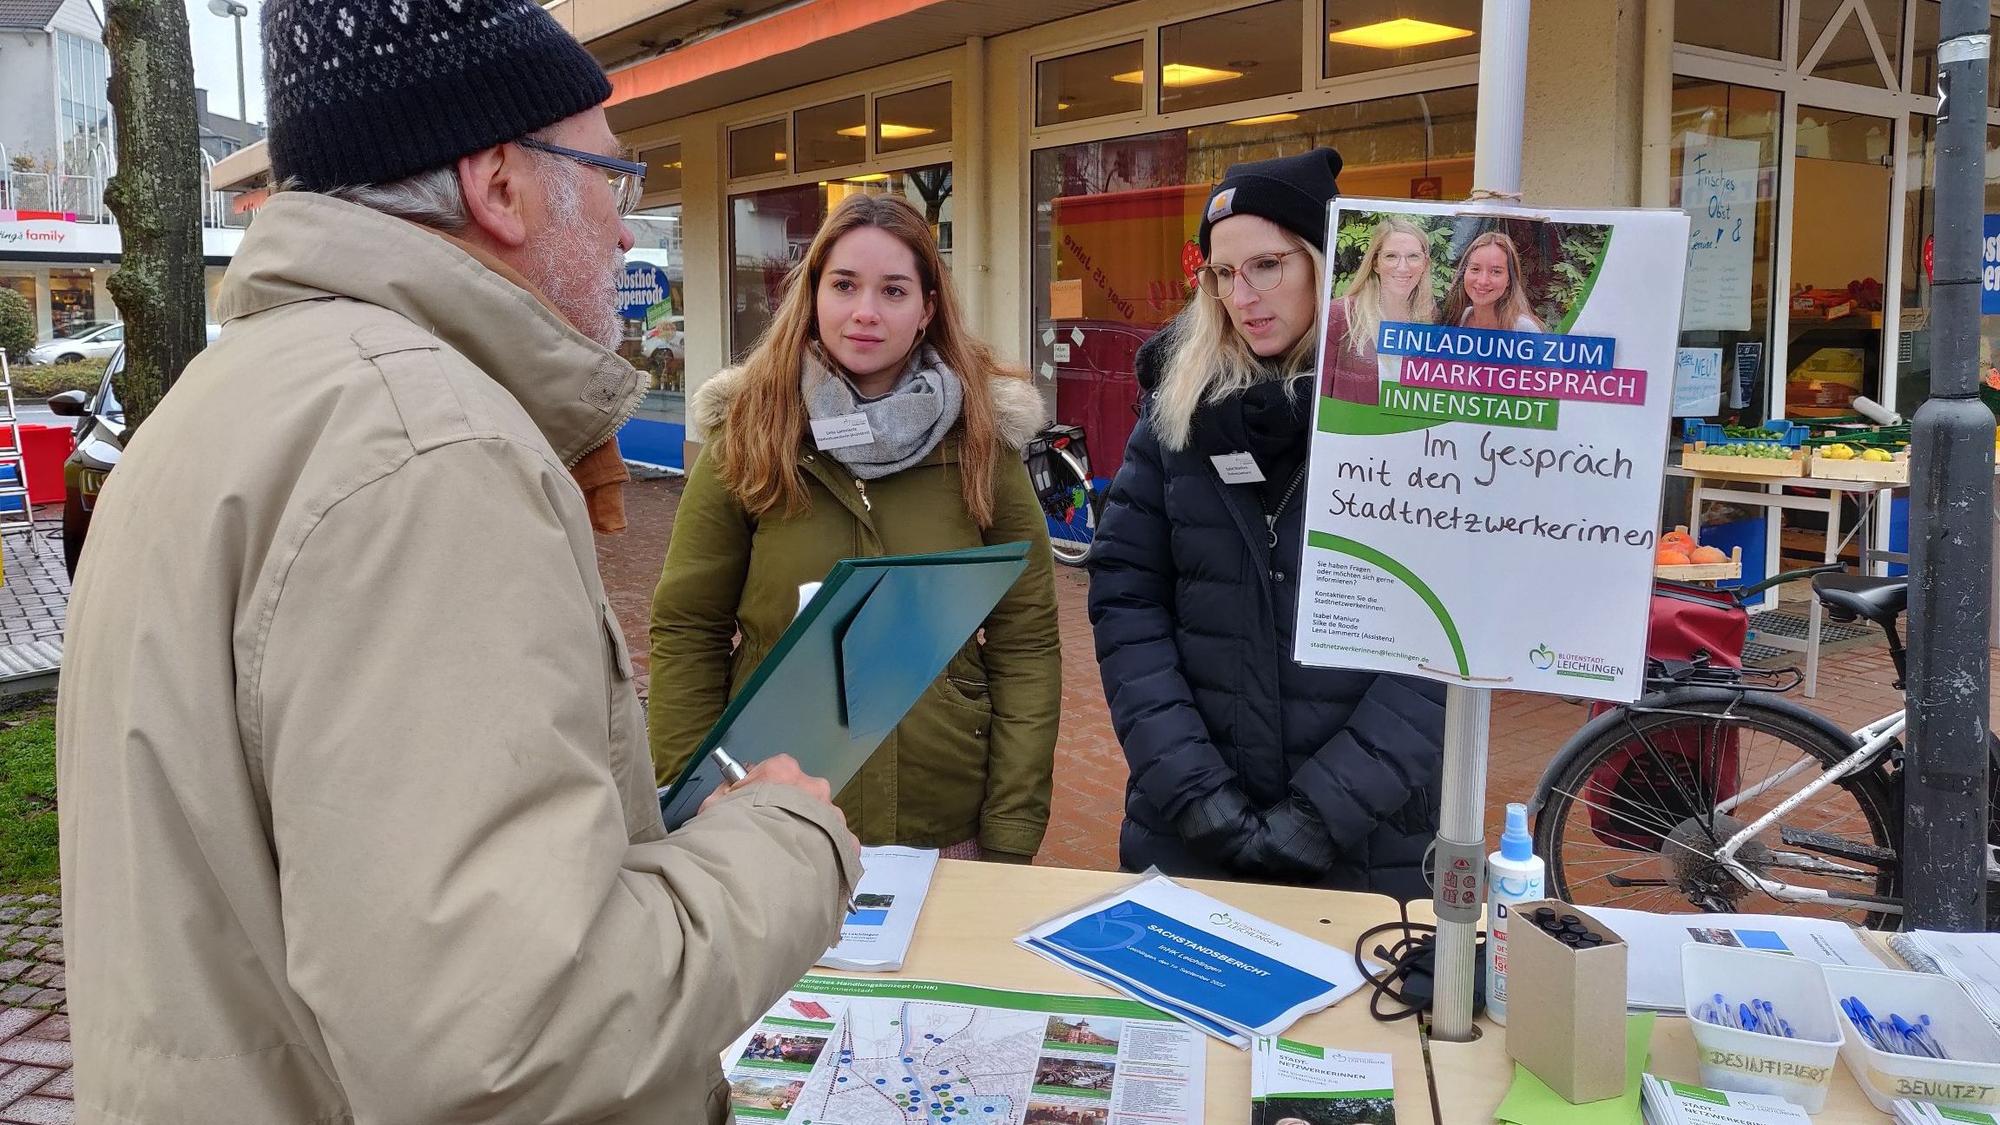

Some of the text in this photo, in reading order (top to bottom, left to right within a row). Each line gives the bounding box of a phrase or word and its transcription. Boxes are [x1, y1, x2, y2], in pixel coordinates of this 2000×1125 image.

[1708, 195, 1731, 219] Obst
[25, 229, 65, 243] family
[617, 284, 664, 310] ppenrodt
[1382, 328, 1604, 365] EINLADUNG ZUM
[1405, 360, 1636, 398] MARKTGESPRÄCH
[1384, 388, 1549, 423] INNENSTADT
[1423, 429, 1633, 487] Im Gespräch
[1337, 457, 1461, 495] mit den
[1328, 489, 1654, 550] Stadtnetzwerkerinnen
[1316, 568, 1395, 584] oder möchten sich gerne
[1317, 560, 1371, 574] Sie haben Fragen
[1316, 576, 1358, 586] informieren?
[1314, 590, 1355, 600] Kontaktieren
[1356, 594, 1366, 602] Sie
[1312, 612, 1360, 623] Isabel Maniura
[1312, 619, 1358, 630] Silke de Roode
[1311, 626, 1395, 643] Lena Lammertz (Assistenz)
[1557, 660, 1624, 676] LEICHLINGEN
[1147, 923, 1271, 978] SACHSTANDSBERICHT
[1158, 944, 1223, 974] InHK Leichlingen
[835, 980, 912, 990] Handlungskonzept
[912, 983, 939, 991] (InHK)
[1278, 1060, 1367, 1080] NETZWERKERINNEN
[1709, 1051, 1831, 1083] DESINFIZIERT
[1895, 1078, 1994, 1099] BENUTZT
